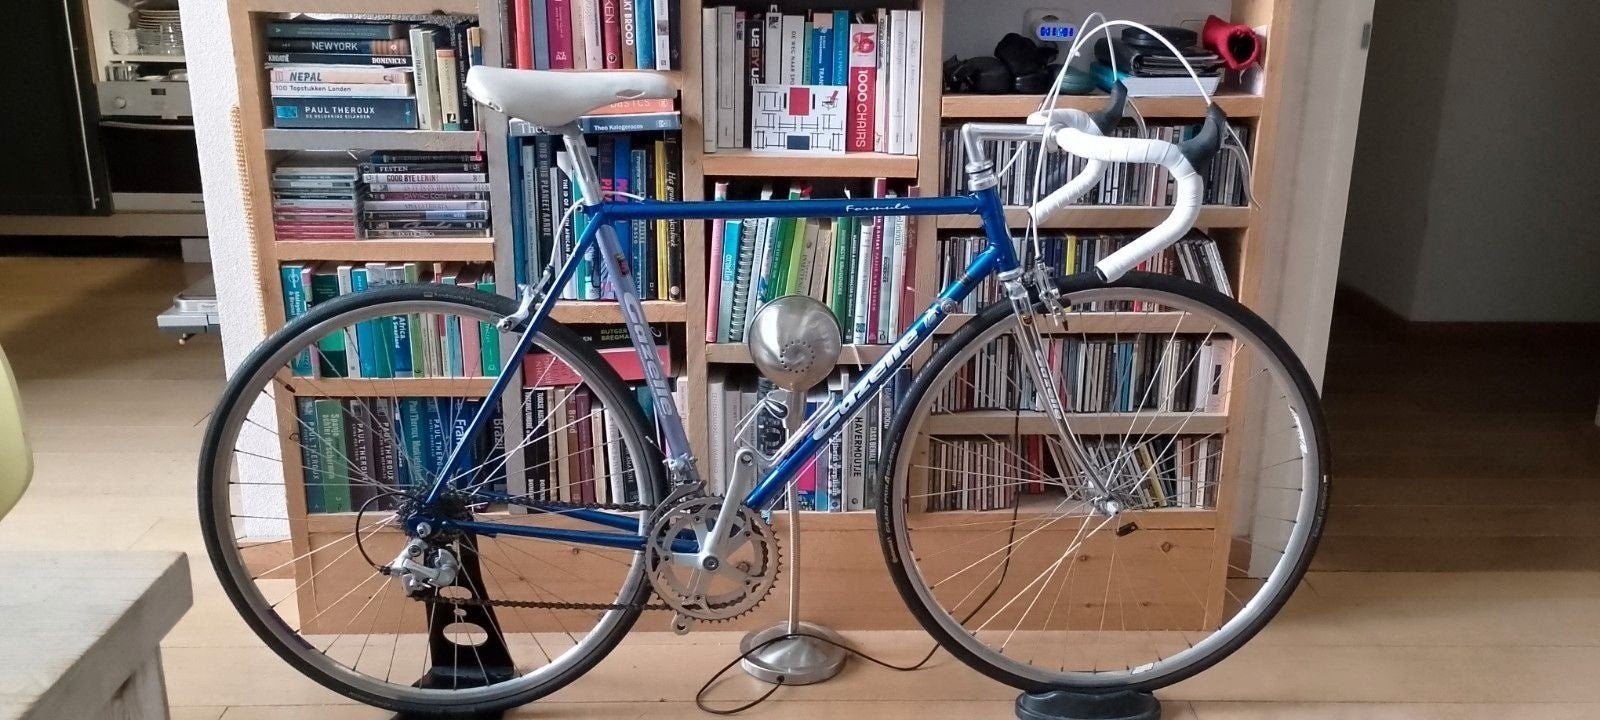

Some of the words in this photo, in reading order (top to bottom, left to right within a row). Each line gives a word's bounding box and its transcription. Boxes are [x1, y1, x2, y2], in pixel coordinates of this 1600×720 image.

[623, 13, 634, 46] BROOD
[372, 57, 407, 65] DOMINICUS
[289, 71, 322, 82] NEPAL
[856, 70, 868, 102] 1000
[304, 106, 330, 114] PAUL
[331, 106, 376, 114] THEROUX
[856, 103, 868, 147] CHAIRS
[386, 174, 403, 182] GOOD
[404, 174, 415, 182] BYE
[540, 179, 550, 211] PLANEET
[845, 203, 911, 213] Formula
[542, 212, 551, 237] AARDE
[392, 321, 400, 349] Swaziland
[624, 292, 673, 418] Gazelle
[812, 329, 919, 441] Gazelle
[356, 423, 365, 444] PAUL
[382, 422, 390, 443] PAUL
[433, 418, 441, 440] PAUL
[493, 418, 505, 450] Brazil
[568, 409, 577, 434] Brood
[869, 426, 877, 441] CASA
[435, 441, 444, 468] THERO
[853, 416, 862, 477] HAVERMOUTJE
[358, 445, 368, 481] THEROUX
[385, 444, 394, 480] THEROUX
